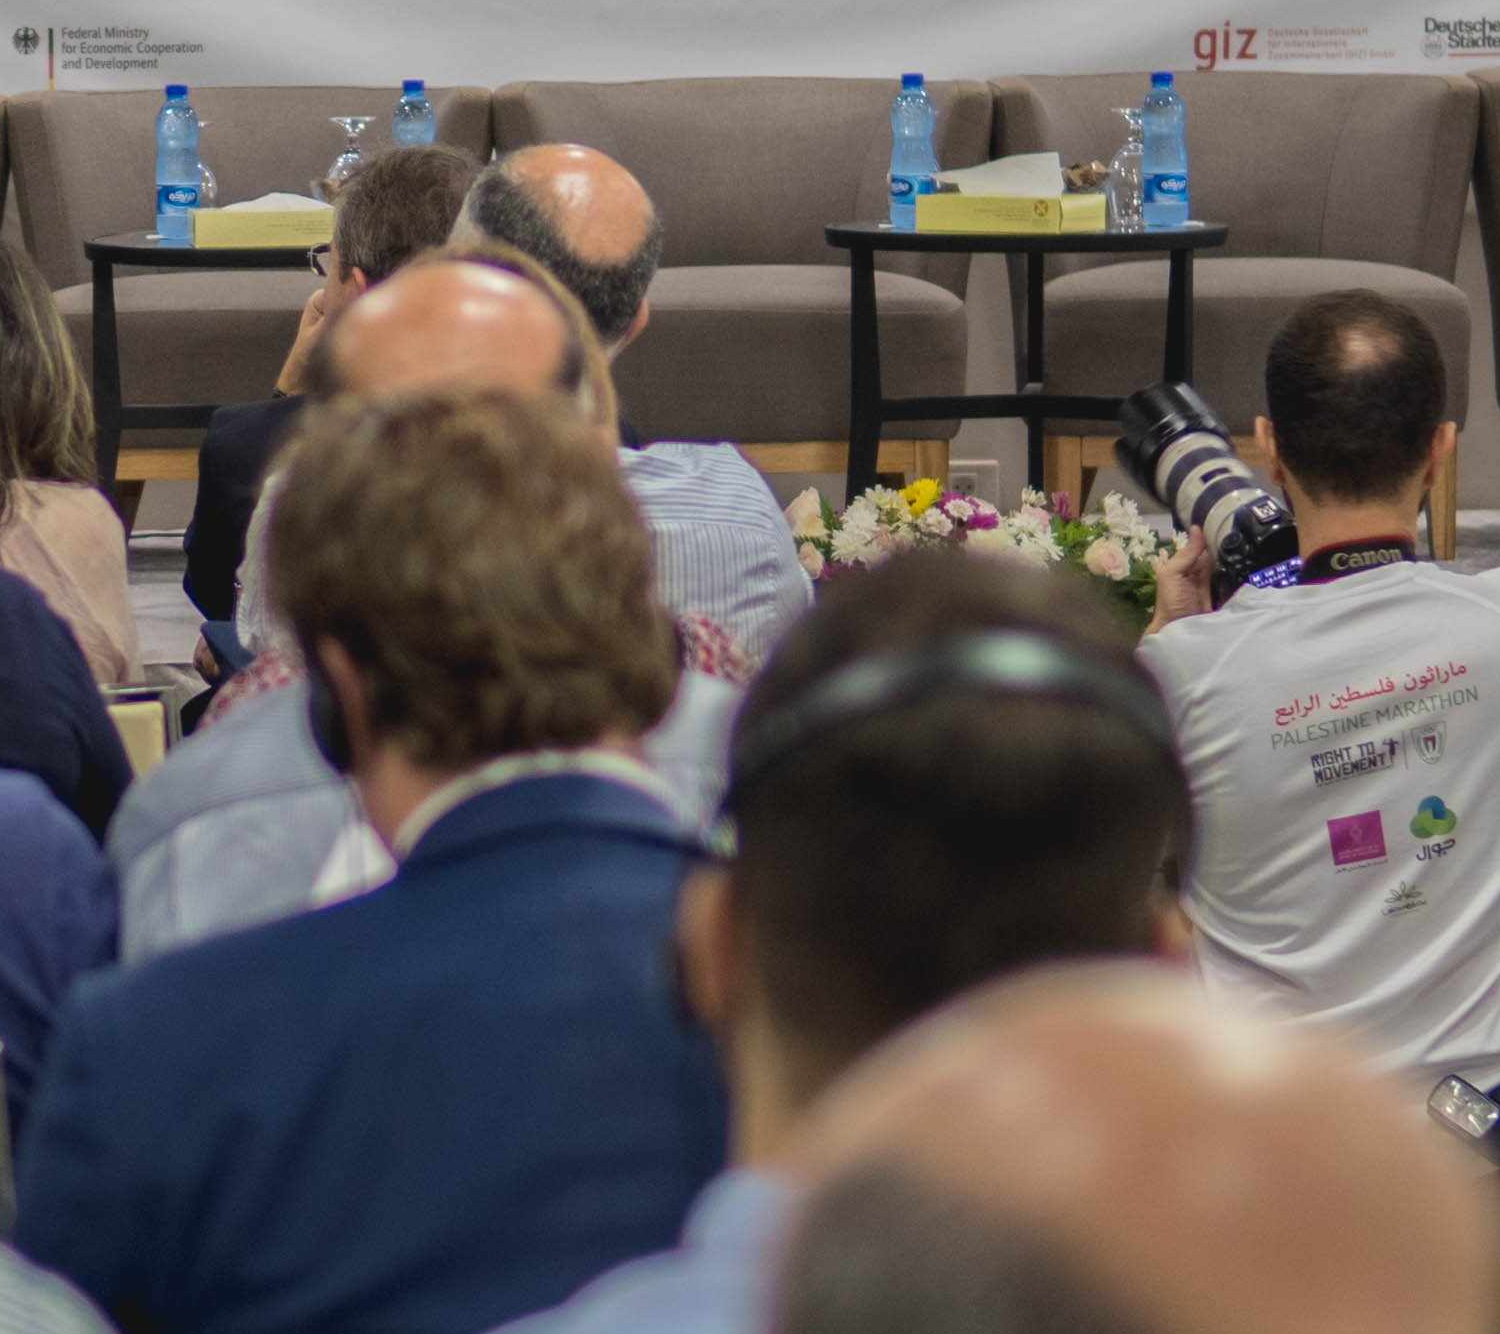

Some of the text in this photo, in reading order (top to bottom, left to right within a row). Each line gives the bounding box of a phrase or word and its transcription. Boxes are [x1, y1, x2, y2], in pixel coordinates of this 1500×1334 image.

[61, 26, 149, 42] Federal Ministry
[1191, 21, 1258, 71] giz
[60, 40, 204, 57] for Economic Cooperation
[61, 56, 159, 72] and Development
[1330, 548, 1402, 571] Canon
[1274, 661, 1468, 727] ماراثون فلسطين الرابع
[1270, 711, 1372, 750] PALESTINE
[1374, 685, 1480, 725] MARATHON
[1310, 741, 1376, 769] RIGHT TO
[1313, 753, 1387, 784] MOVEMENT
[1415, 838, 1457, 862] جوال
